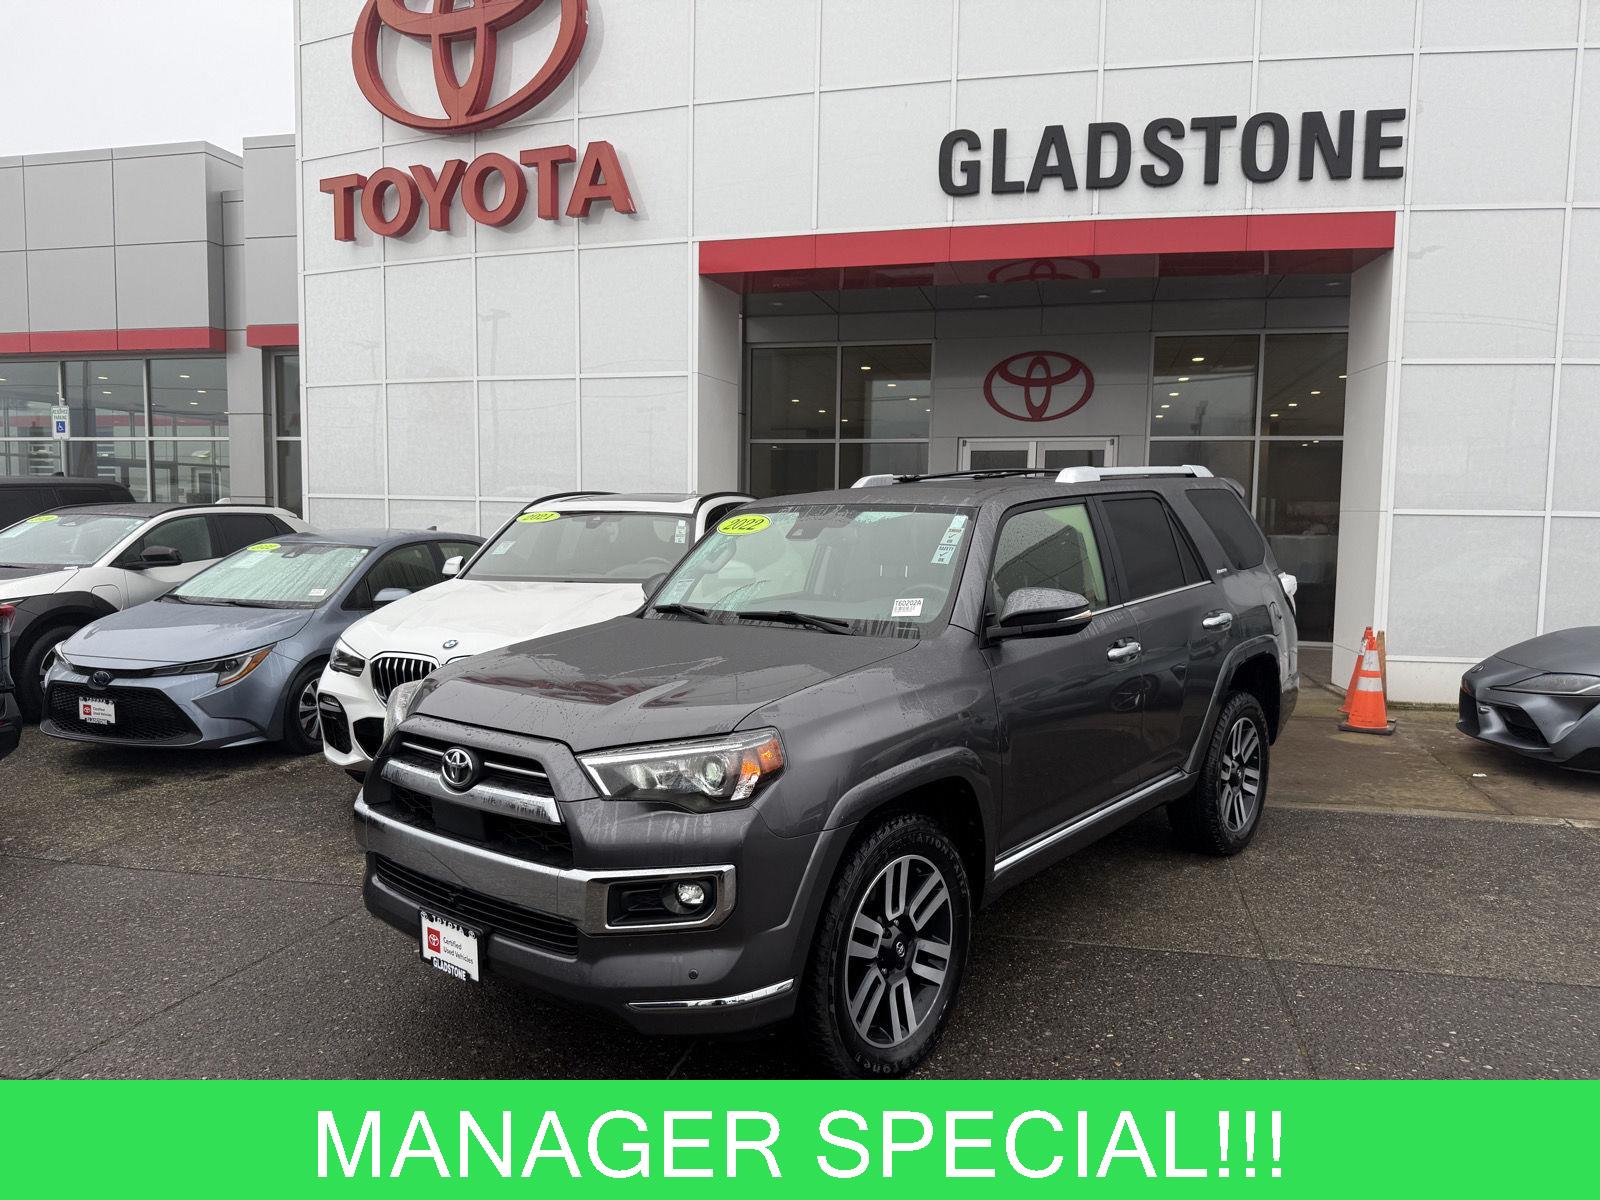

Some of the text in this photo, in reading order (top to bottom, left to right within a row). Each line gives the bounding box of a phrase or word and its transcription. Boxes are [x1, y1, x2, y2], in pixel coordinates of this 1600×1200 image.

[938, 108, 1406, 197] GLADSTONE
[319, 140, 637, 242] TOYOTA
[721, 518, 766, 531] 2022
[443, 936, 462, 950] Certified
[443, 946, 474, 965] Used Vehicles
[432, 957, 467, 981] GLADSTONE
